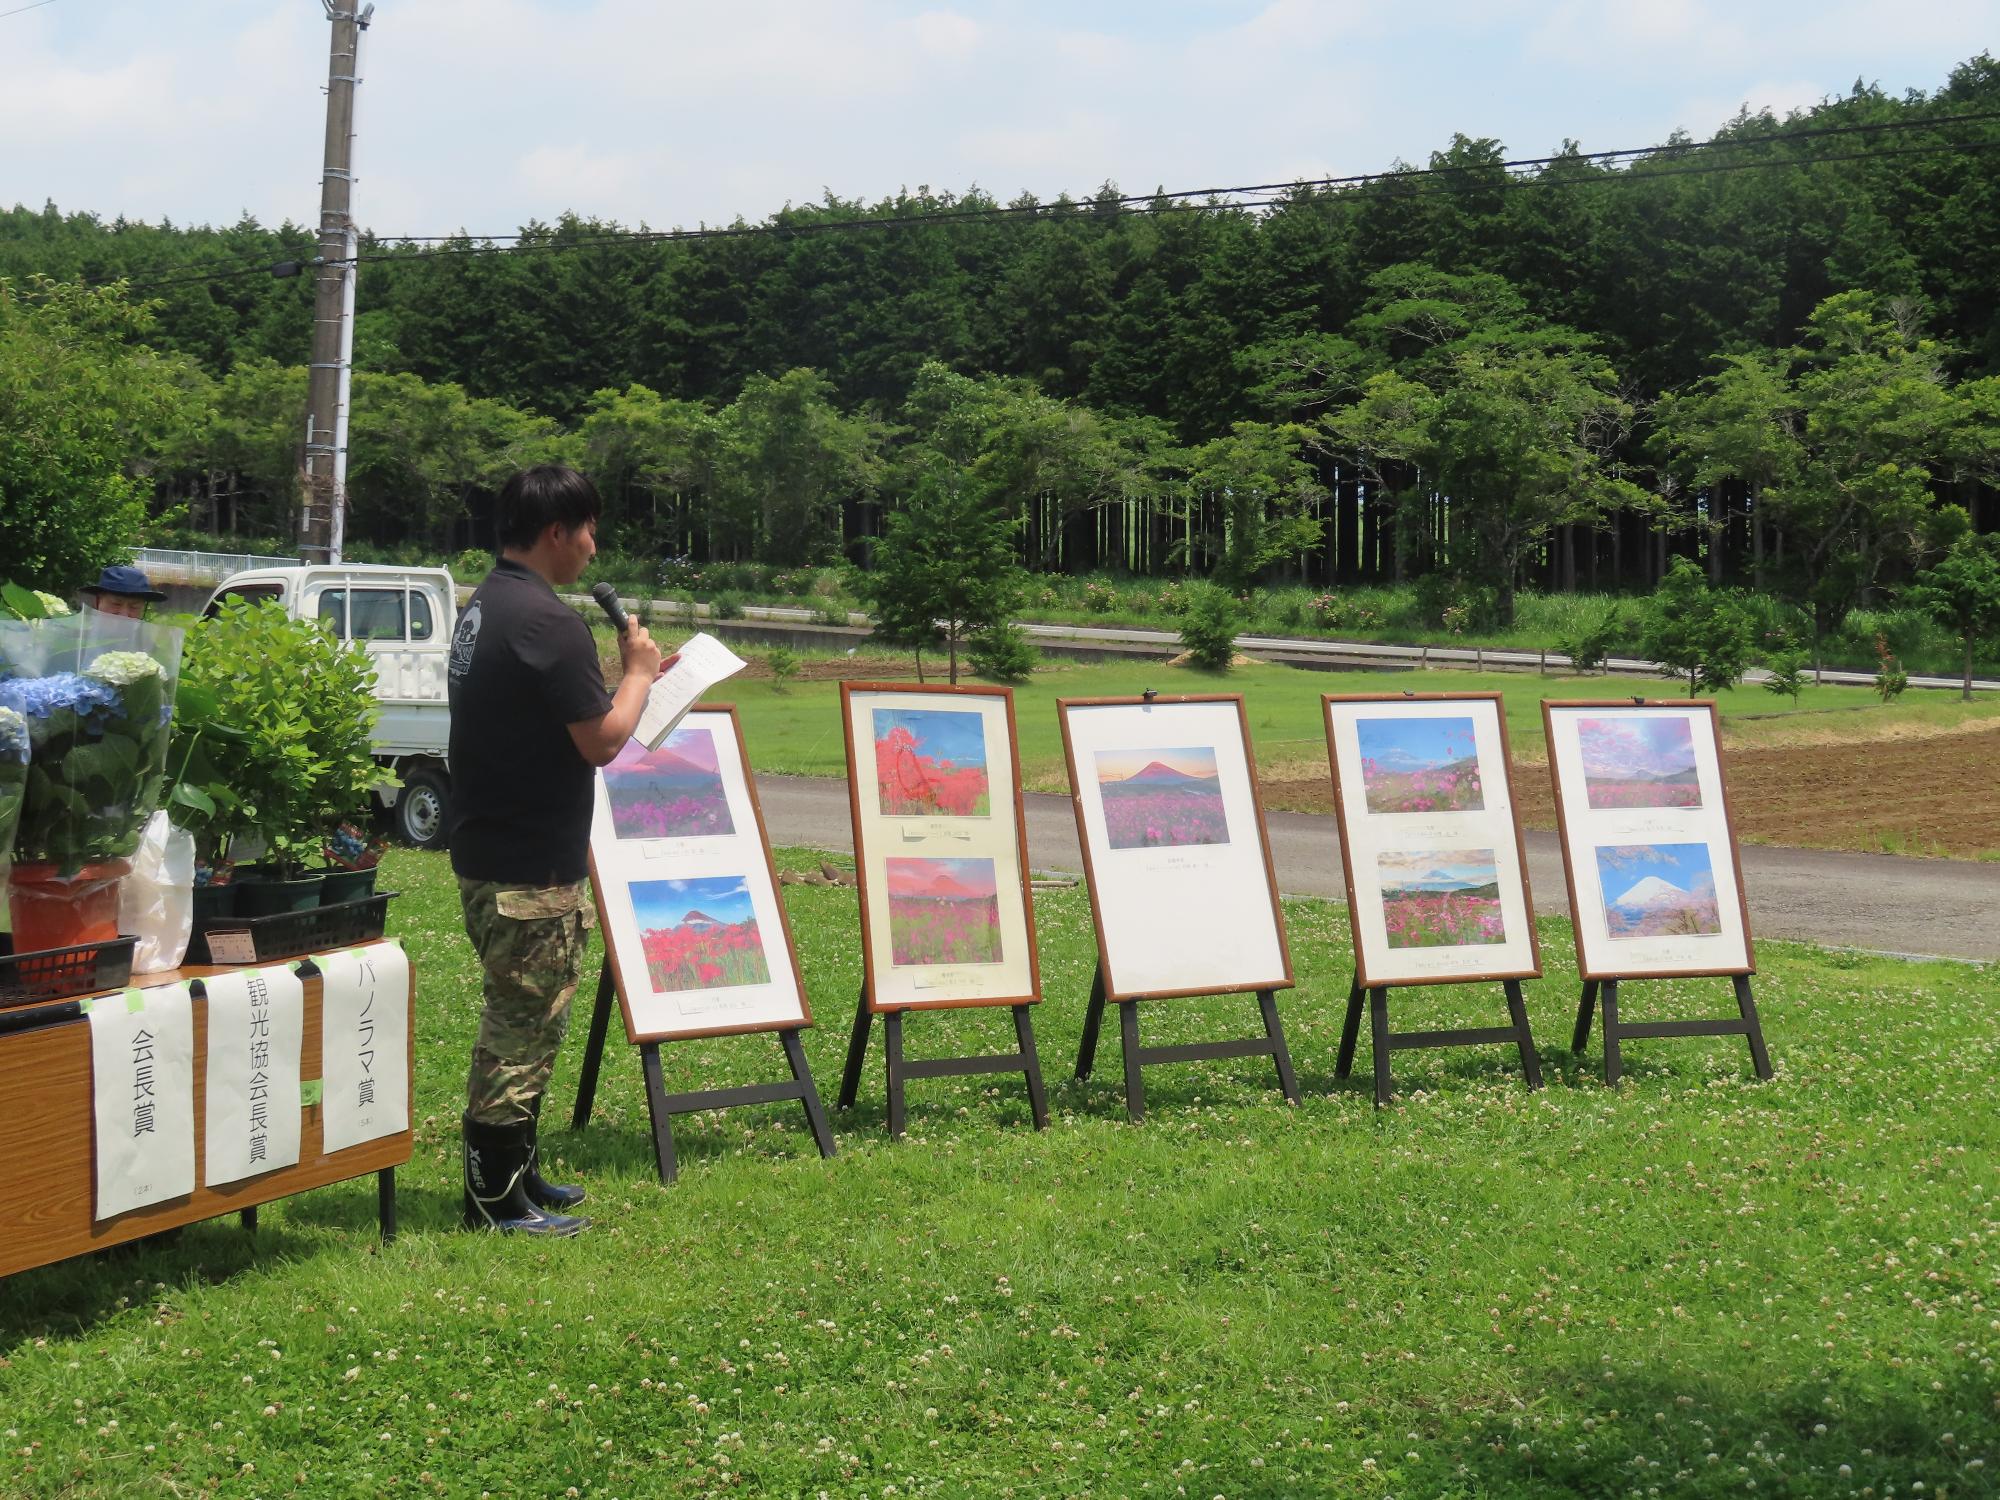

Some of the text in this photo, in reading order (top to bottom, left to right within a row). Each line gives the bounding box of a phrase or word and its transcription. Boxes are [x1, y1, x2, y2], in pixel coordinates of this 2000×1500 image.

[132, 1029, 156, 1138] 会長賞
[247, 978, 270, 1163] 観光協会長賞
[358, 960, 376, 1107] パノラマ賞
[469, 1145, 487, 1189] XEBEC
